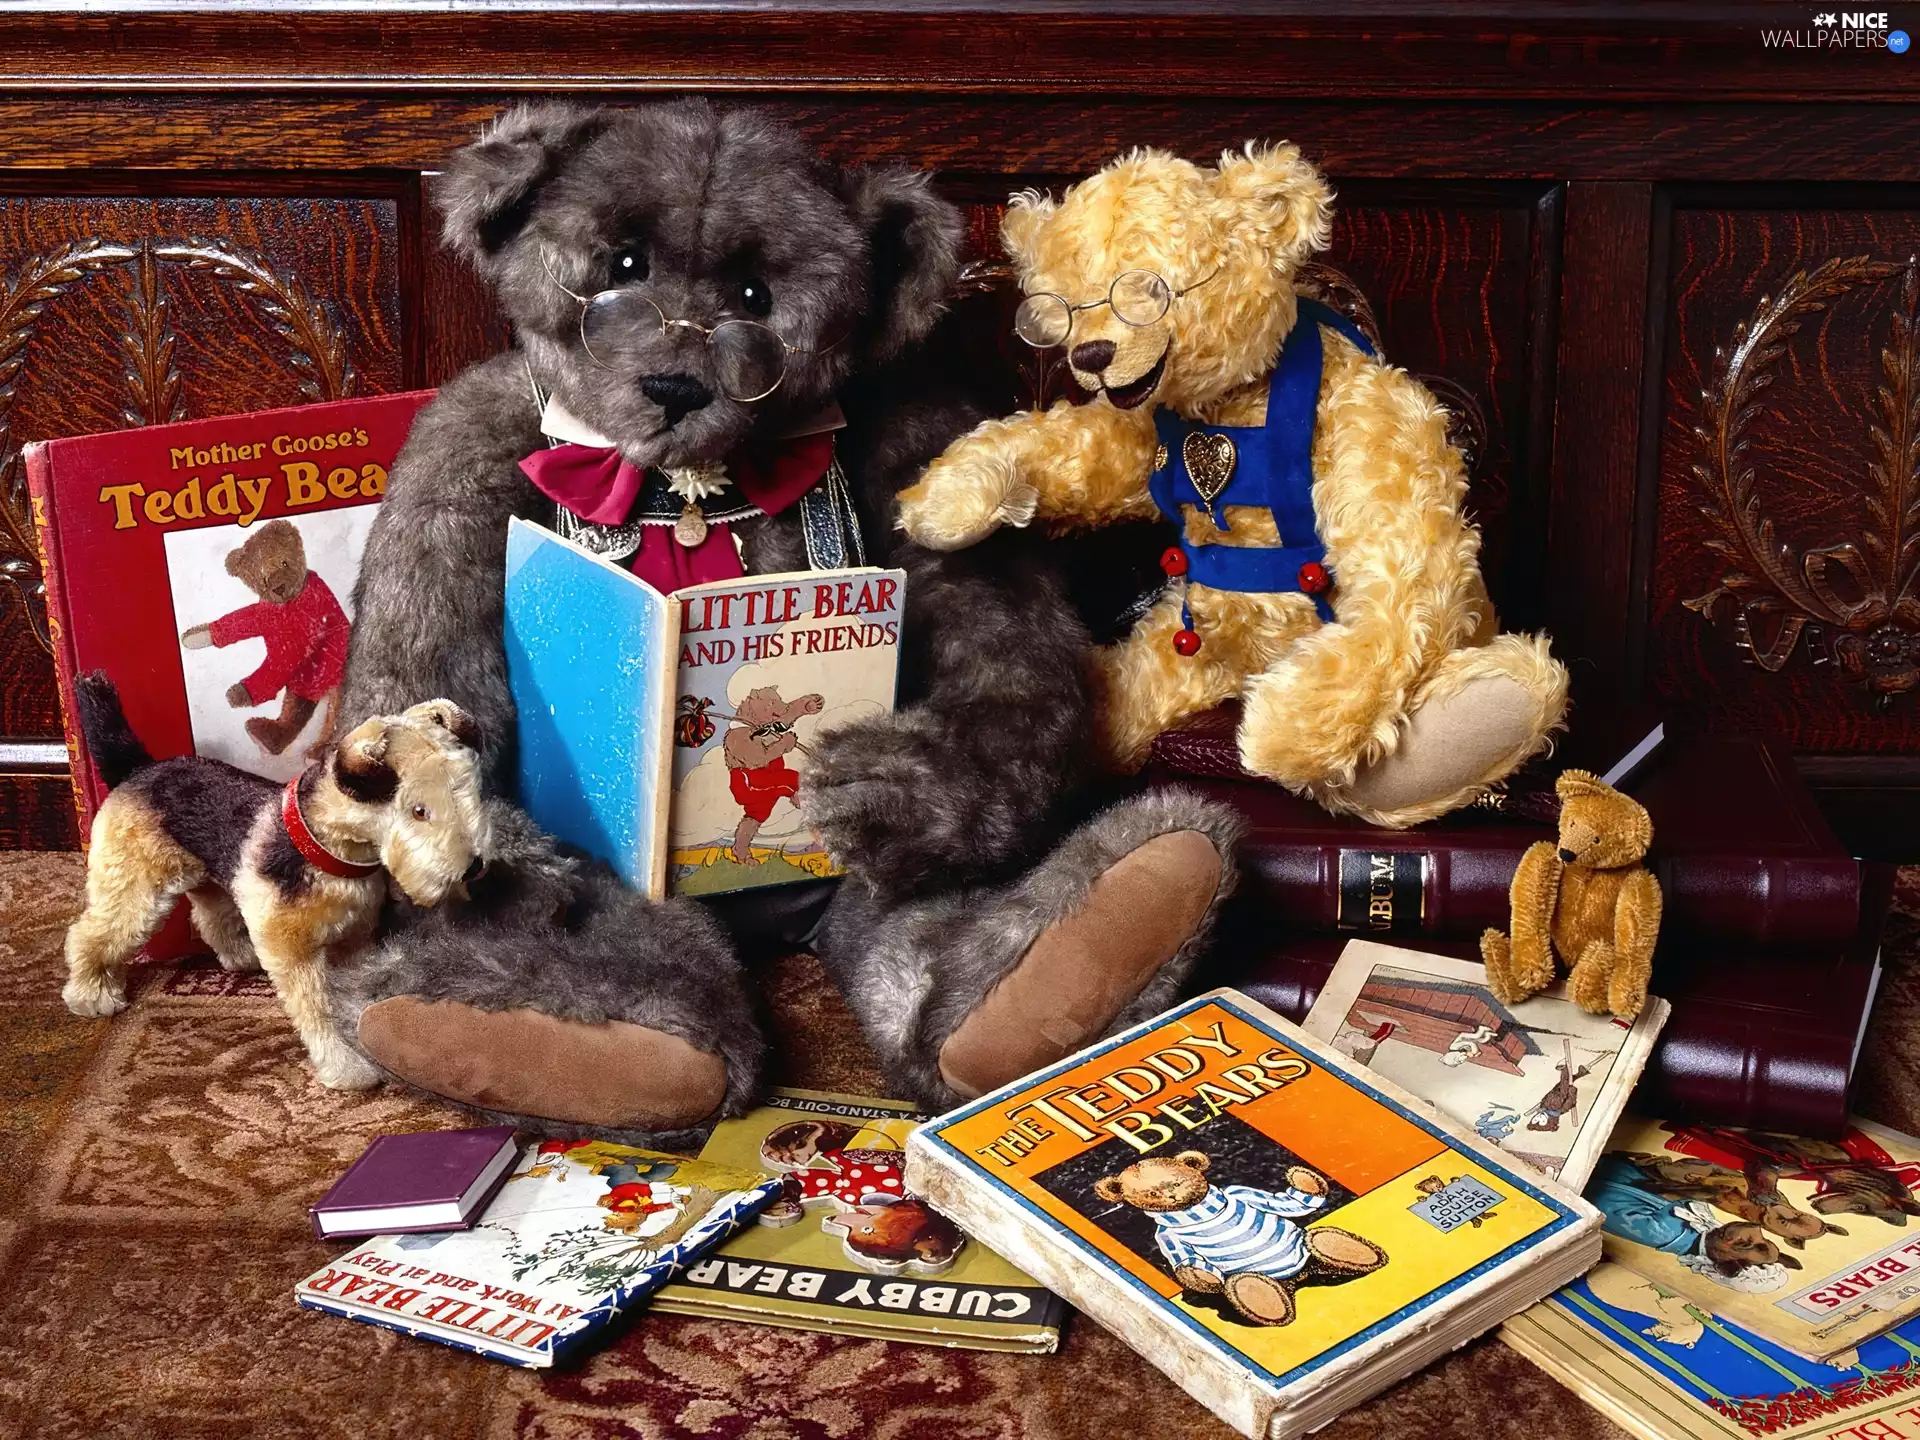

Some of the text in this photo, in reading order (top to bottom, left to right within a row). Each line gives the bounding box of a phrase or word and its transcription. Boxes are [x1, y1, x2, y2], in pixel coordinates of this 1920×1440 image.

[170, 427, 370, 470] Mother Goose's
[99, 461, 389, 529] Teddy Bea
[680, 578, 898, 634] LITTLE BEAR
[678, 621, 899, 669] AND HIS FRIENDS
[766, 1096, 790, 1108] BO
[794, 1101, 891, 1119] STAND-OUT
[976, 1021, 1244, 1166] THE TEDDY
[1099, 1048, 1312, 1155] BEARS
[1429, 1187, 1469, 1214] ADAH
[1431, 1190, 1484, 1221] LOUISE
[1440, 1195, 1497, 1229] SUTTON
[343, 1251, 400, 1277] Play
[400, 1265, 431, 1279] at
[423, 1272, 479, 1292] and
[1809, 1257, 1911, 1308] BEARS
[476, 1284, 543, 1314] Work
[686, 1259, 1032, 1318] CUBBY BEAR
[307, 1268, 560, 1348] LITTLE BEAR
